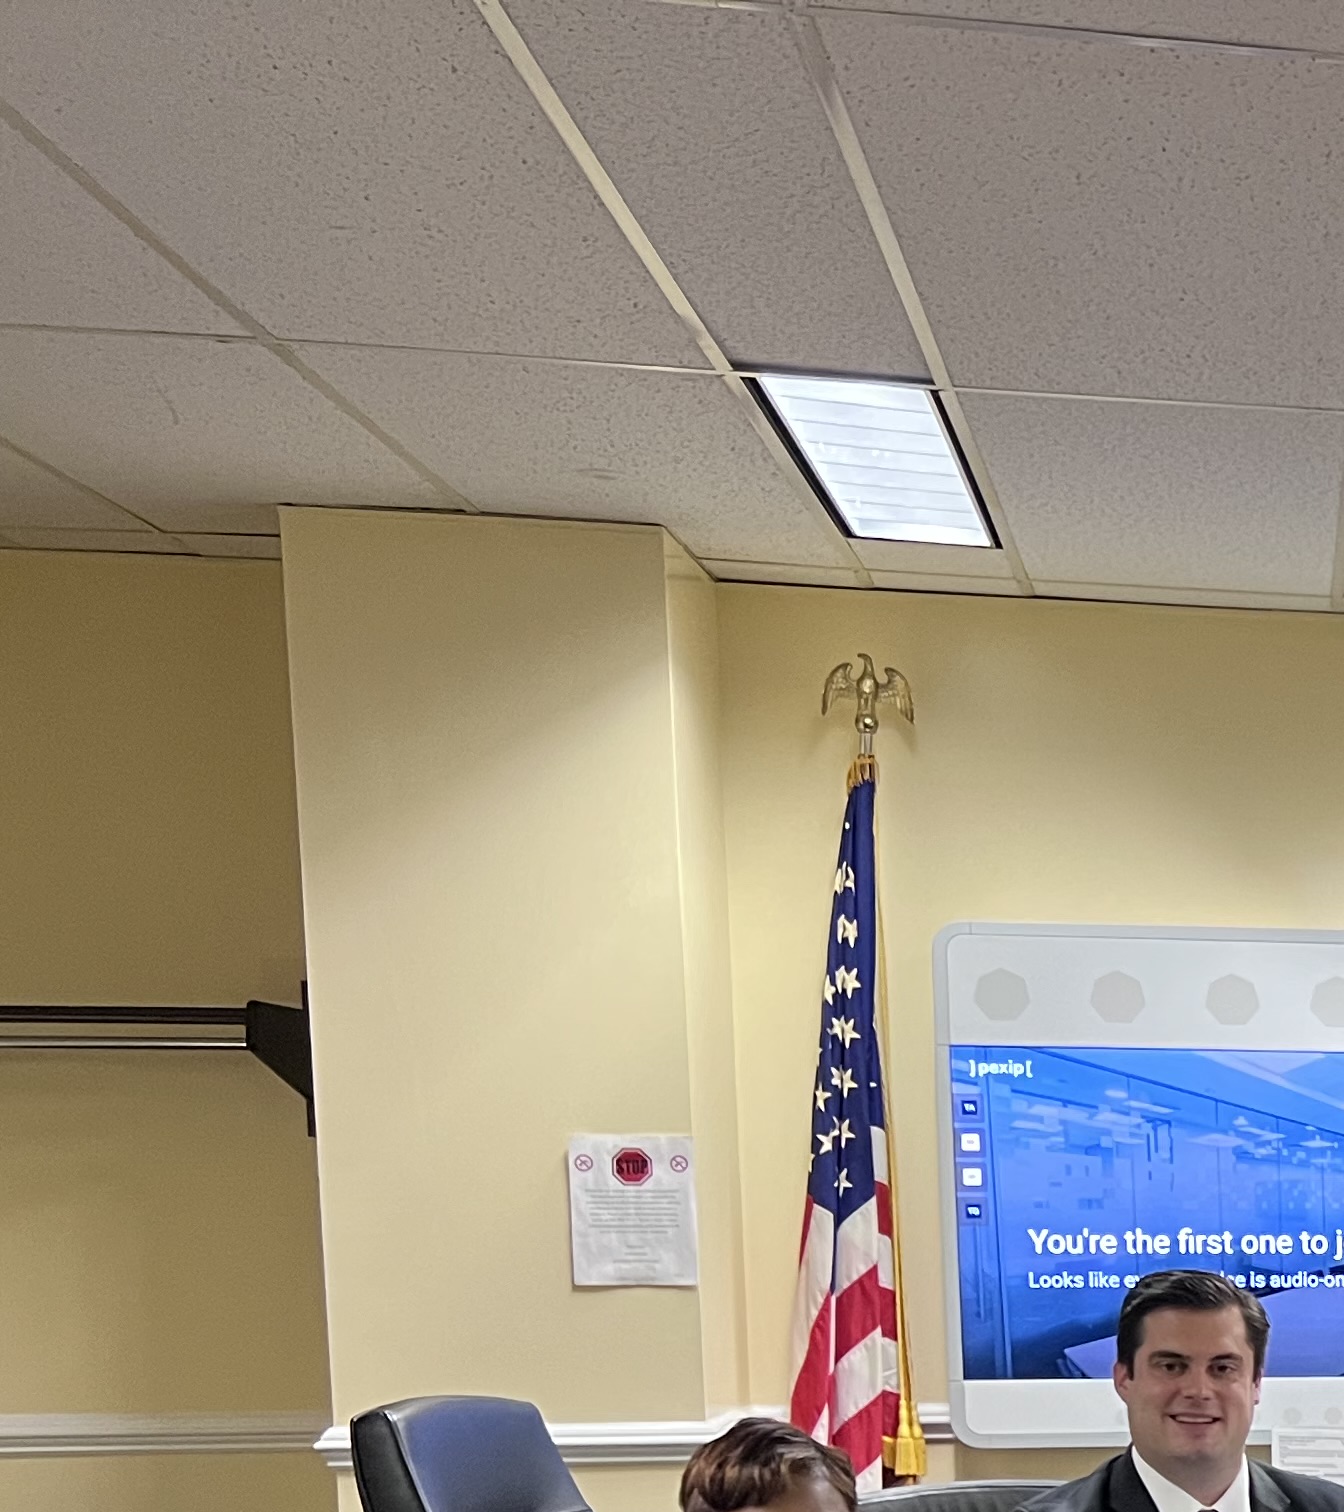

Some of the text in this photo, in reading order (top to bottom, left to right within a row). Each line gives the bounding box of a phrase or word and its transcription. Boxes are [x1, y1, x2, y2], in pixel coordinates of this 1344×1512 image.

[615, 1158, 649, 1176] STOP
[1027, 1228, 1118, 1255] You're
[1124, 1228, 1171, 1255] the
[1177, 1227, 1234, 1255] first
[1240, 1233, 1294, 1255] one
[1300, 1231, 1329, 1255] to
[1028, 1271, 1085, 1289] Looks
[1089, 1270, 1121, 1289] like
[1249, 1271, 1266, 1288] is
